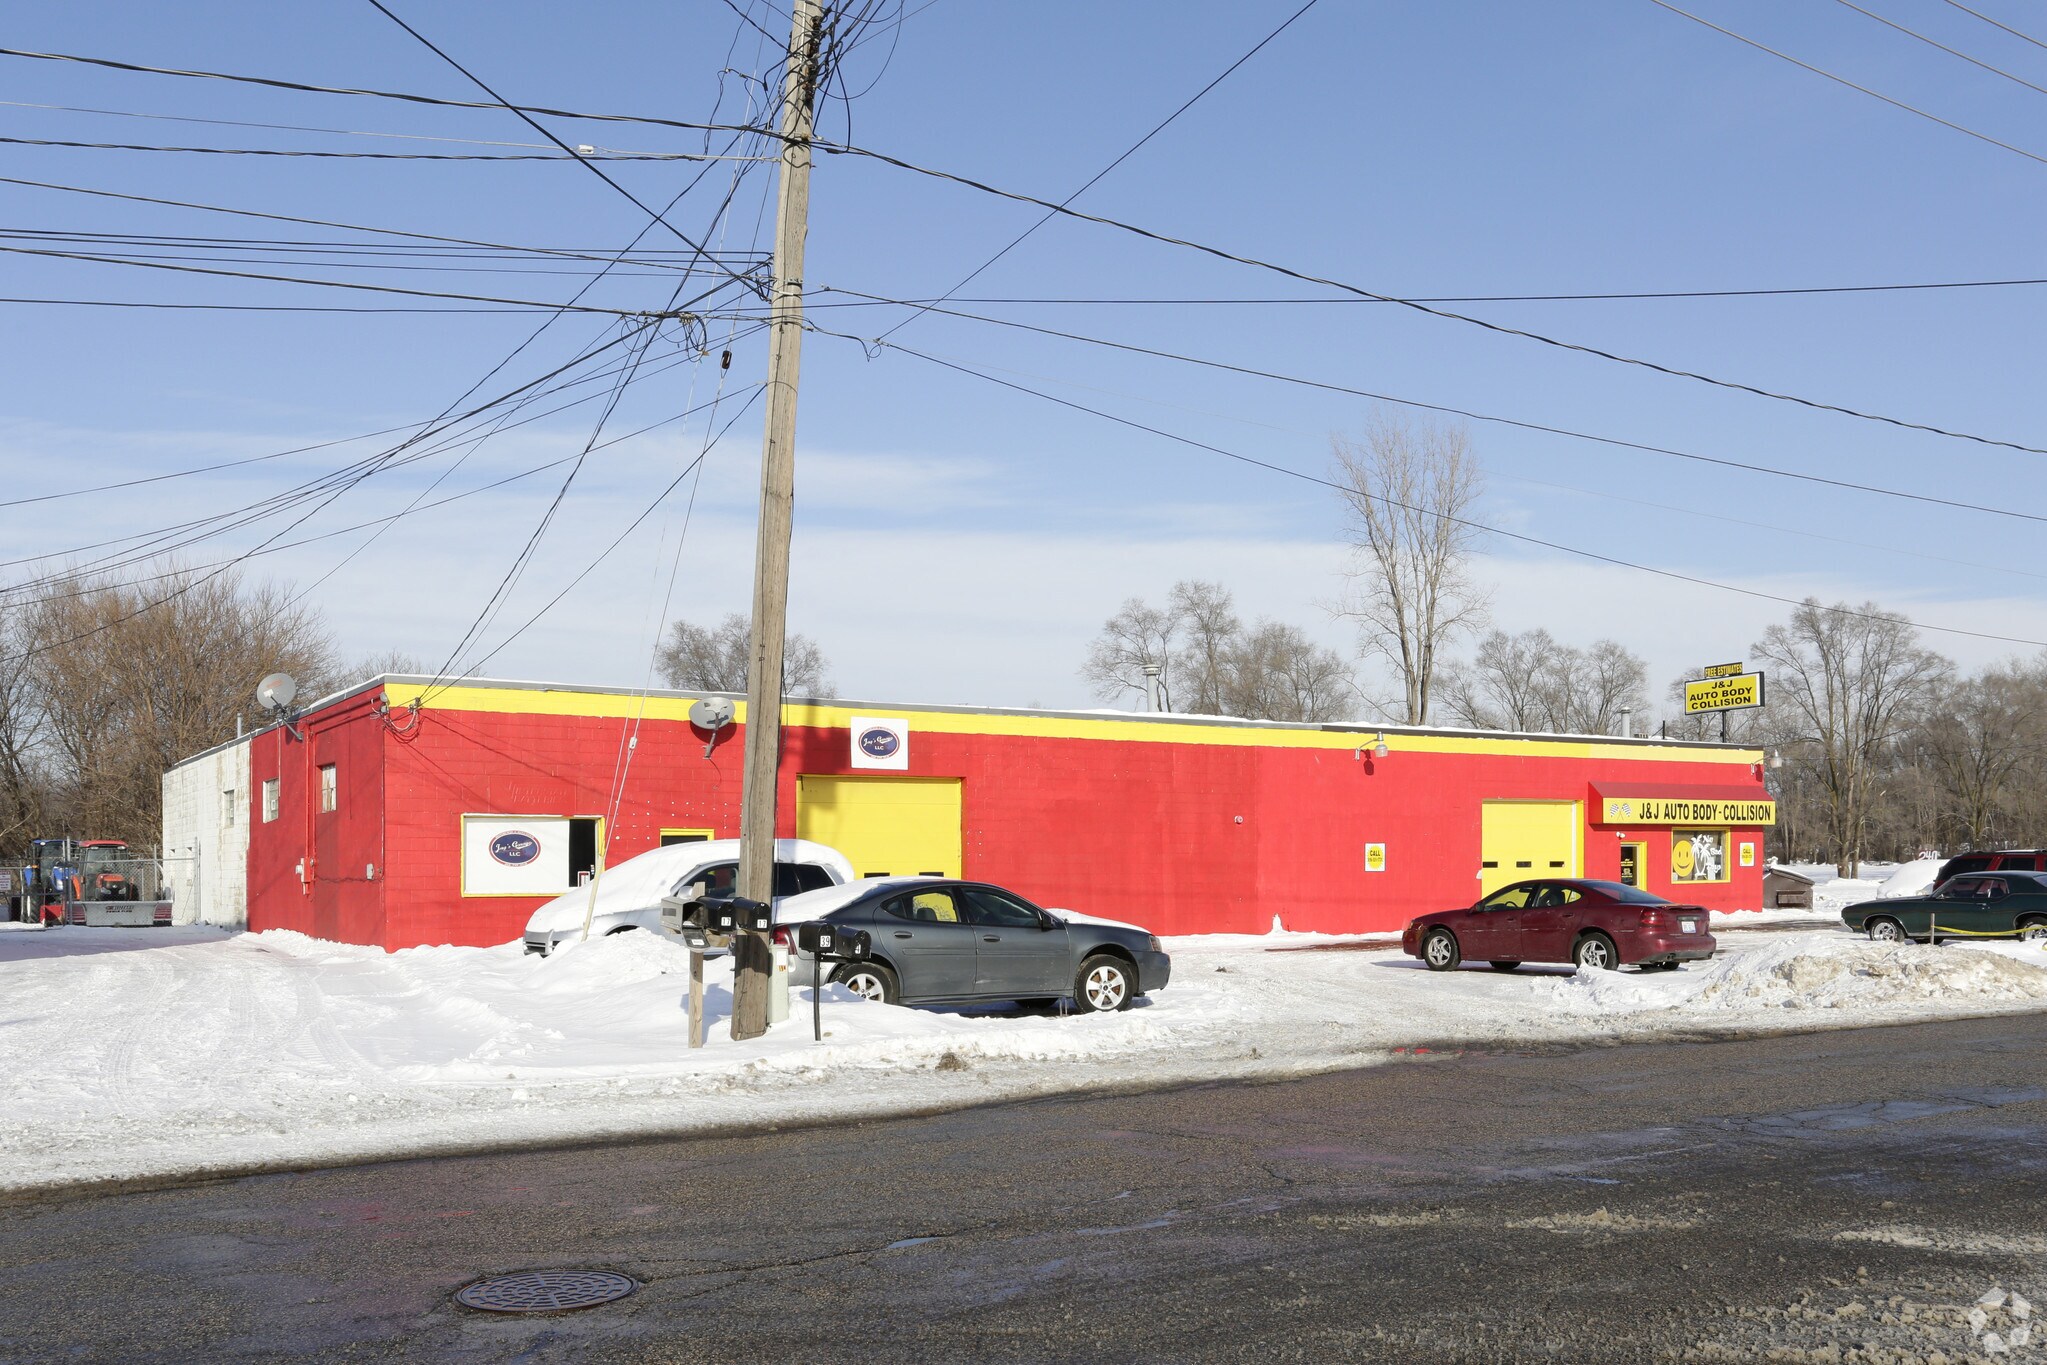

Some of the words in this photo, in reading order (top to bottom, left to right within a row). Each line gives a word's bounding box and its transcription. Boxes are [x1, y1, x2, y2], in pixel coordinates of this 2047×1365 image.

[1704, 667, 1717, 677] FREE
[1717, 663, 1742, 676] ESTIMATES
[1711, 680, 1733, 689] J&J
[1689, 691, 1718, 701] AUTO
[1721, 687, 1752, 697] BODY
[1691, 696, 1751, 709] COLLISION
[1639, 802, 1659, 820] J&J
[1663, 803, 1690, 820] AUTO
[722, 917, 731, 925] 17
[758, 920, 767, 928] 17
[821, 936, 830, 947] 39
